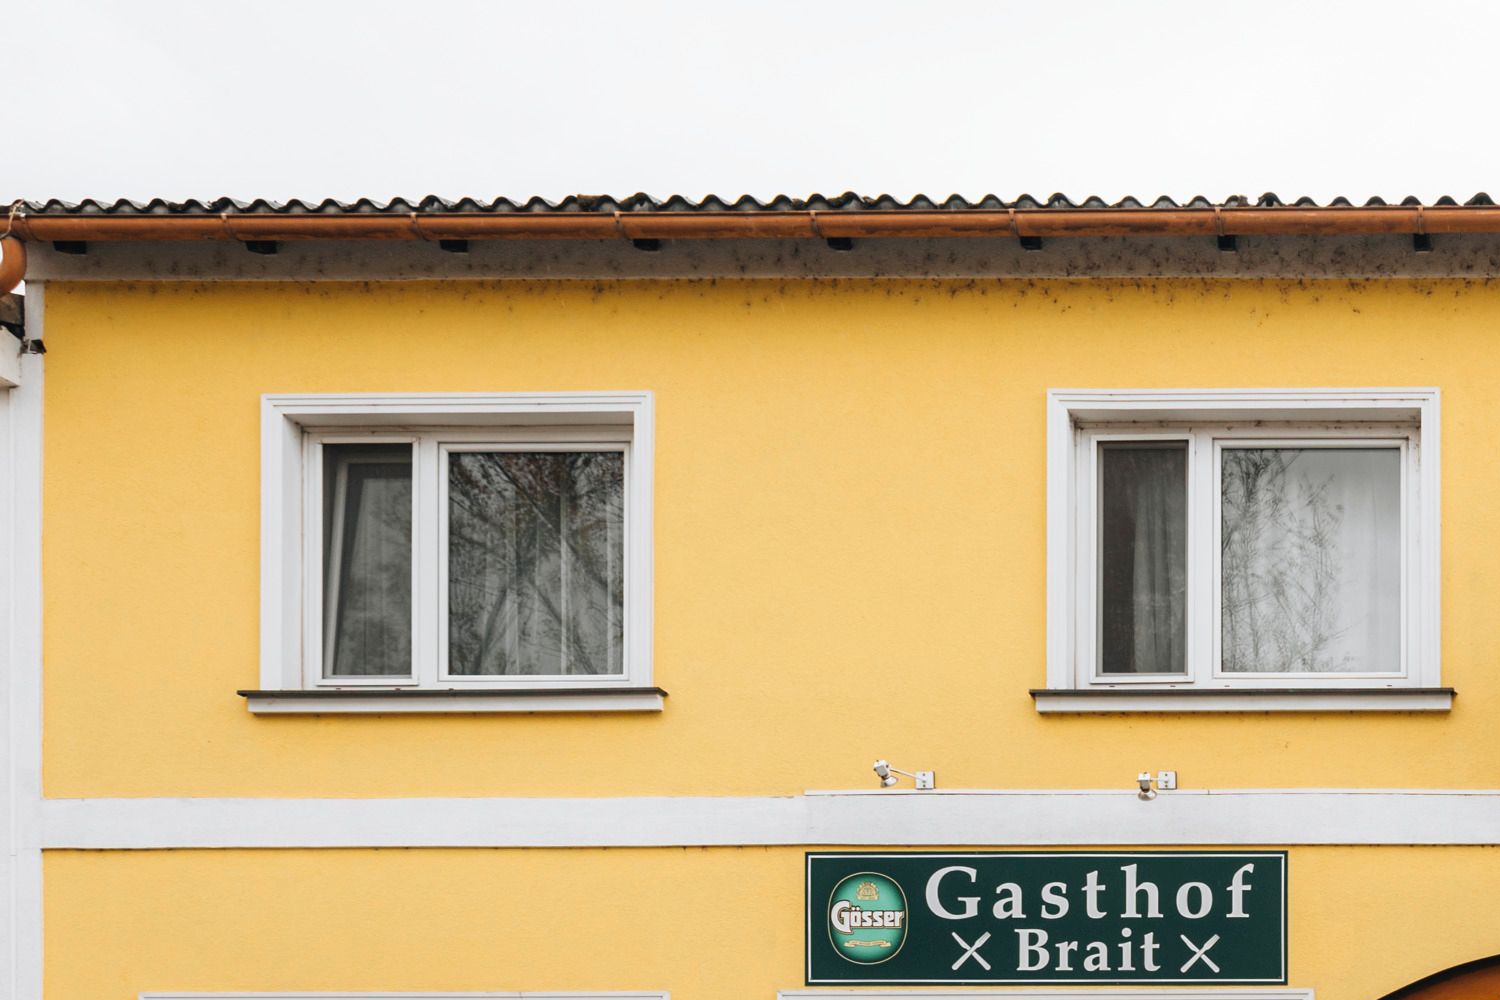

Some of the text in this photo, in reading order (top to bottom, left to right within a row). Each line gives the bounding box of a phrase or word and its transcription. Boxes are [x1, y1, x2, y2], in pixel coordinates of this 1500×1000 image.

[925, 863, 1254, 920] Gasthof
[830, 900, 905, 934] Gösser
[1014, 927, 1162, 972] Brait
